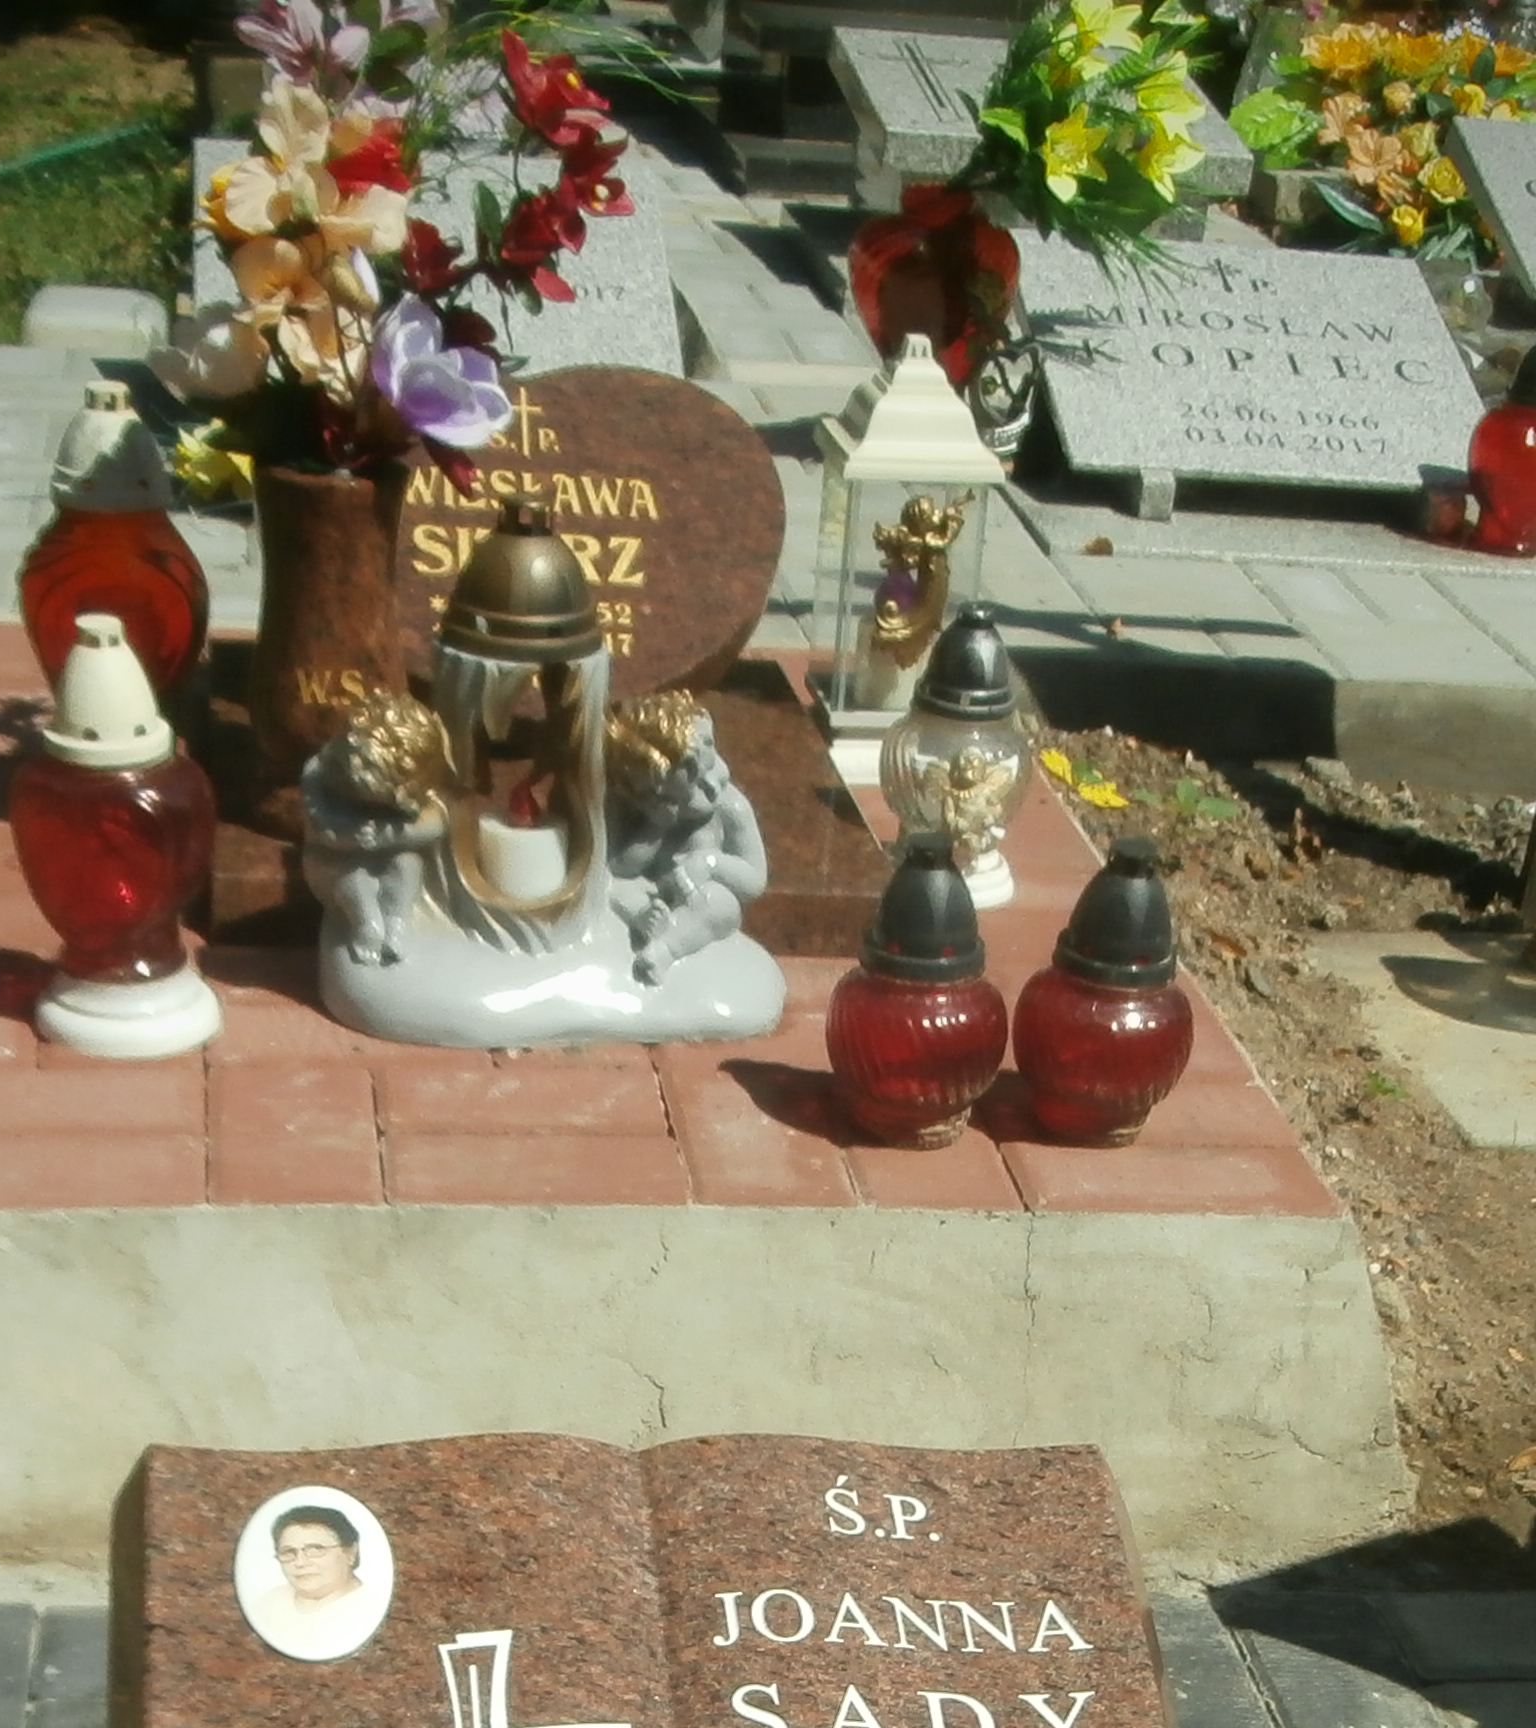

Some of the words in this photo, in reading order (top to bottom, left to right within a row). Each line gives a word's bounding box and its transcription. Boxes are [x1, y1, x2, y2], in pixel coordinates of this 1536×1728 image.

[1080, 338, 1435, 385] KOPIEC
[823, 1475, 943, 1542] Ś.P.
[713, 1588, 1094, 1653] JOANNA
